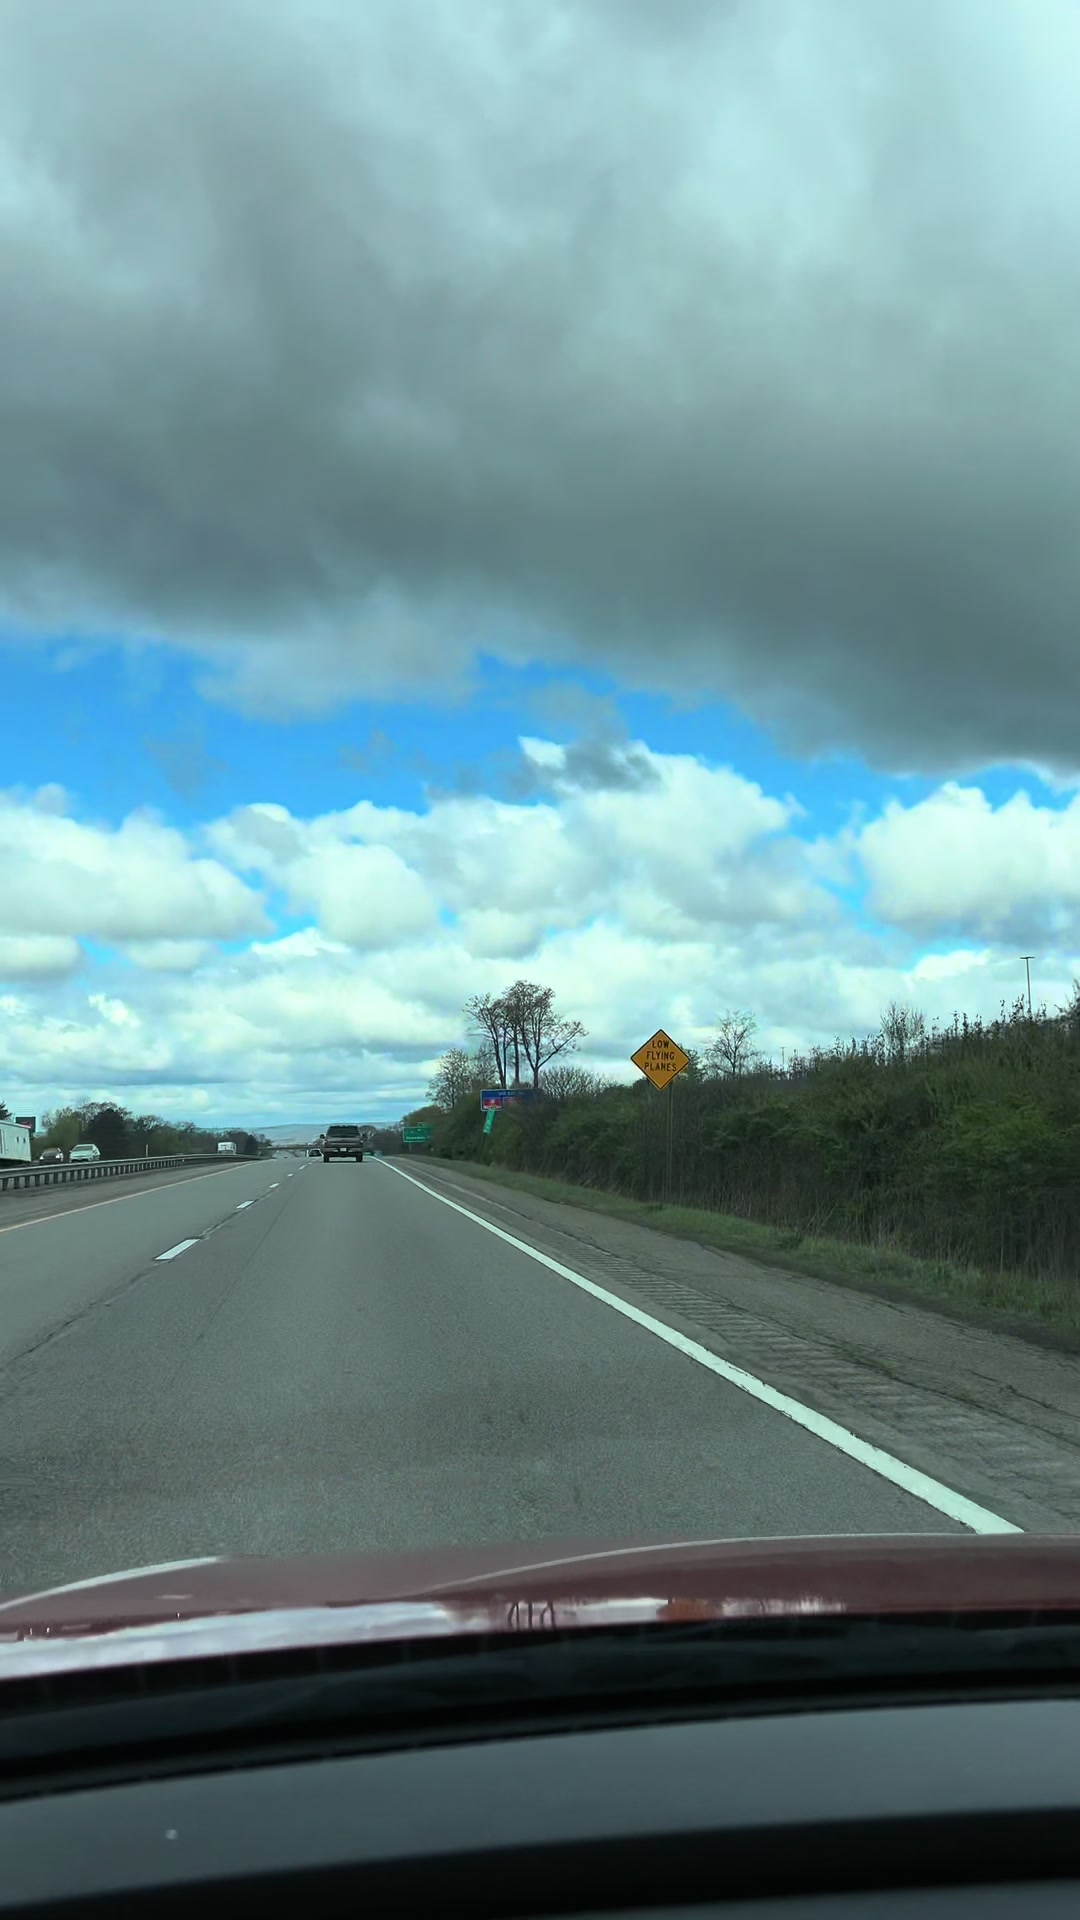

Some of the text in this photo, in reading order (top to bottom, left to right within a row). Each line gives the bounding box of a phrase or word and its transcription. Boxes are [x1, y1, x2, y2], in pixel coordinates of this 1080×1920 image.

[652, 1040, 670, 1048] LOW
[646, 1051, 675, 1060] FLYING
[644, 1062, 677, 1071] PLANES
